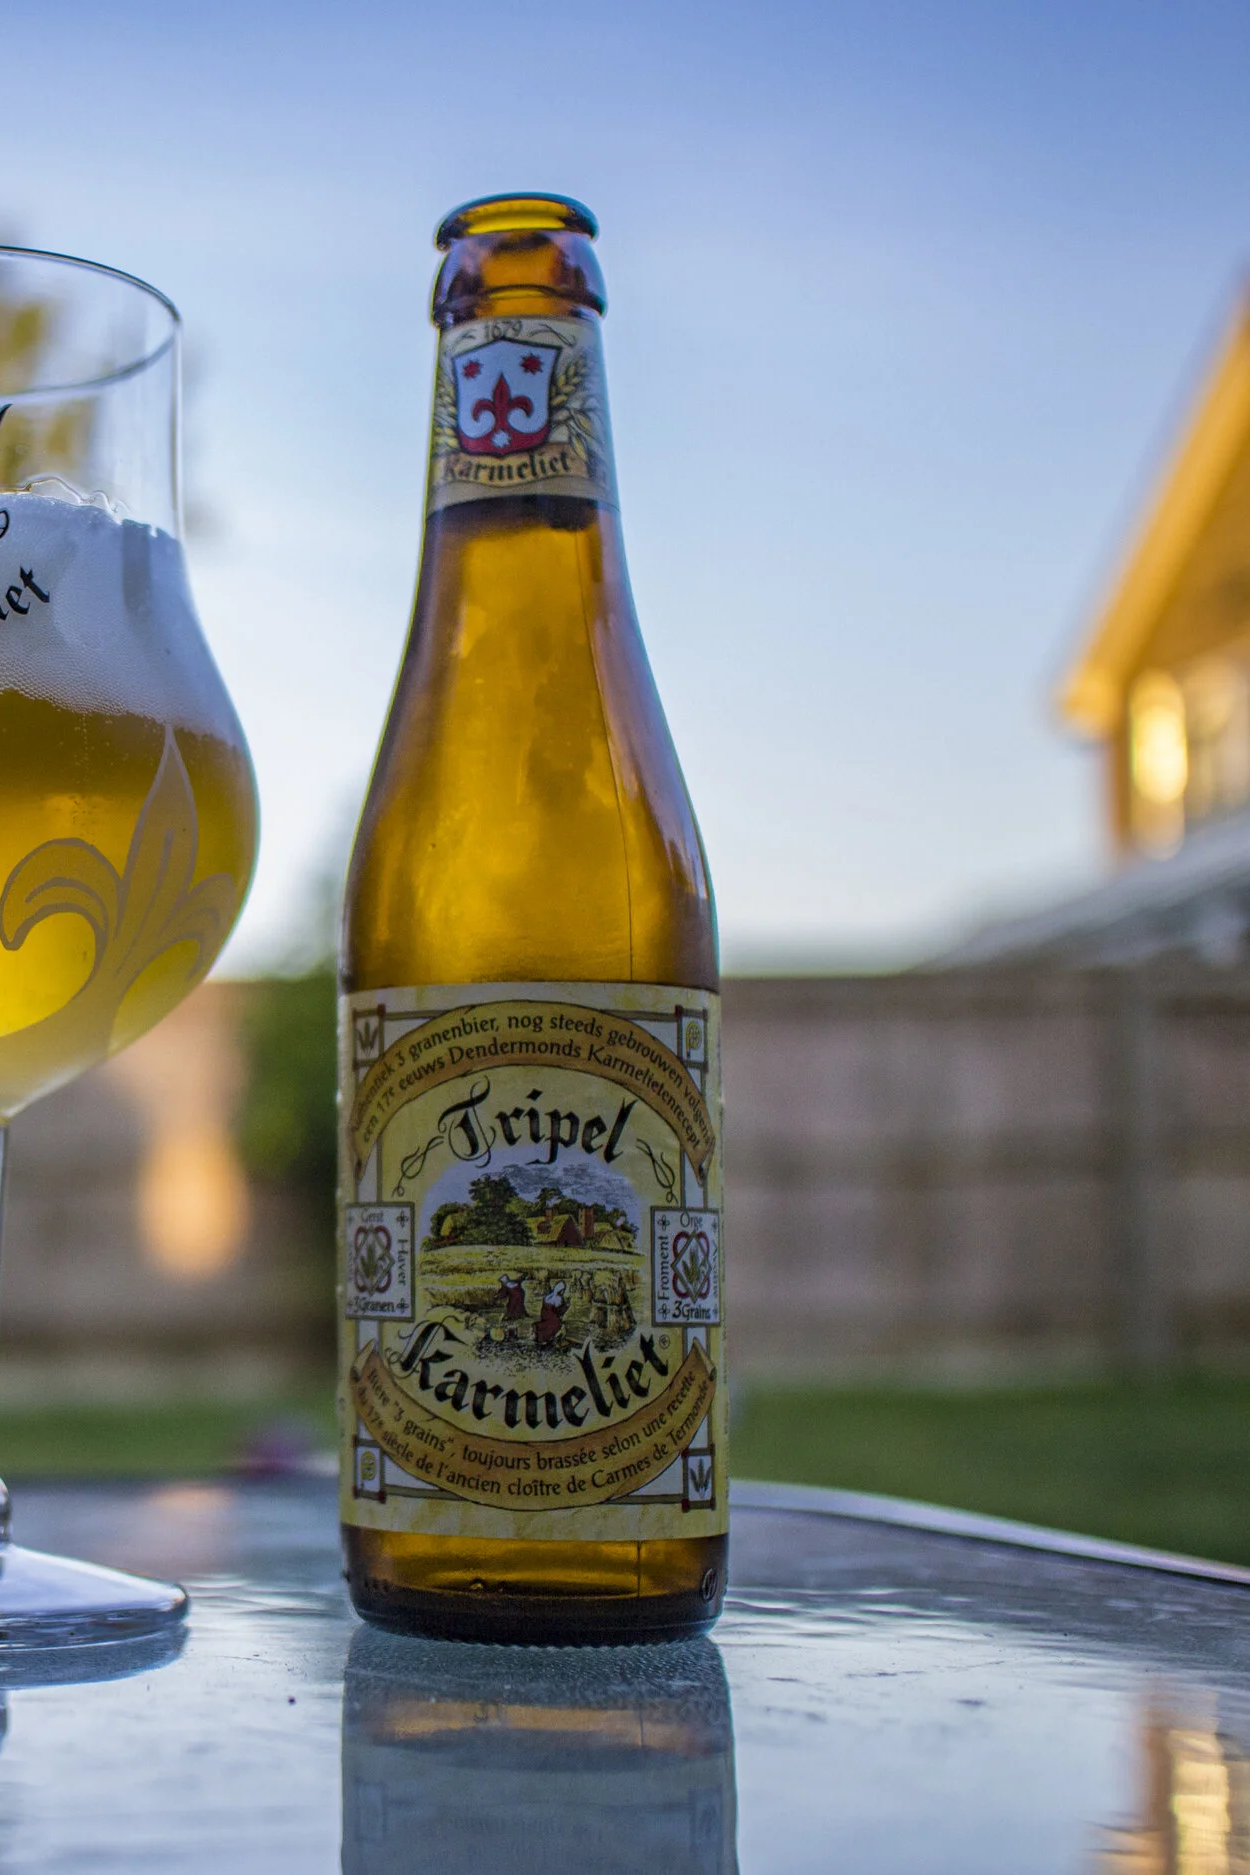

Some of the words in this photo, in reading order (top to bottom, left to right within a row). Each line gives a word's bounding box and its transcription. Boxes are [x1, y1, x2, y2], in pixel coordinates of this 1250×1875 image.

[444, 450, 570, 481] Karmeliet
[364, 1114, 379, 1144] een
[398, 1056, 446, 1091] eeuws
[447, 1037, 582, 1065] Dendermonds
[587, 1043, 701, 1149] Karmelietenrecept
[395, 1049, 406, 1067] 3
[409, 1017, 499, 1062] granenbier,
[507, 1015, 544, 1032] nog
[550, 1014, 603, 1038] steeds
[606, 1029, 684, 1088] gebrouwen
[683, 1085, 712, 1145] volgens
[437, 1075, 639, 1168] Tripel
[397, 1239, 409, 1286] Haver
[657, 1234, 670, 1301] Froment
[679, 1211, 704, 1231] Orge
[385, 1320, 669, 1430] Karmeliet
[463, 1444, 531, 1471] toujours
[537, 1448, 598, 1471] brassée
[602, 1432, 641, 1460] selon
[642, 1412, 667, 1438] une
[666, 1371, 696, 1416] recette
[381, 1430, 415, 1461] siècle
[415, 1454, 433, 1474] de
[436, 1462, 501, 1494] l'ancien
[508, 1477, 562, 1497] cloître
[566, 1475, 588, 1494] de
[591, 1456, 651, 1489] Carmes
[652, 1443, 669, 1462] de
[666, 1380, 709, 1446] Termonde
